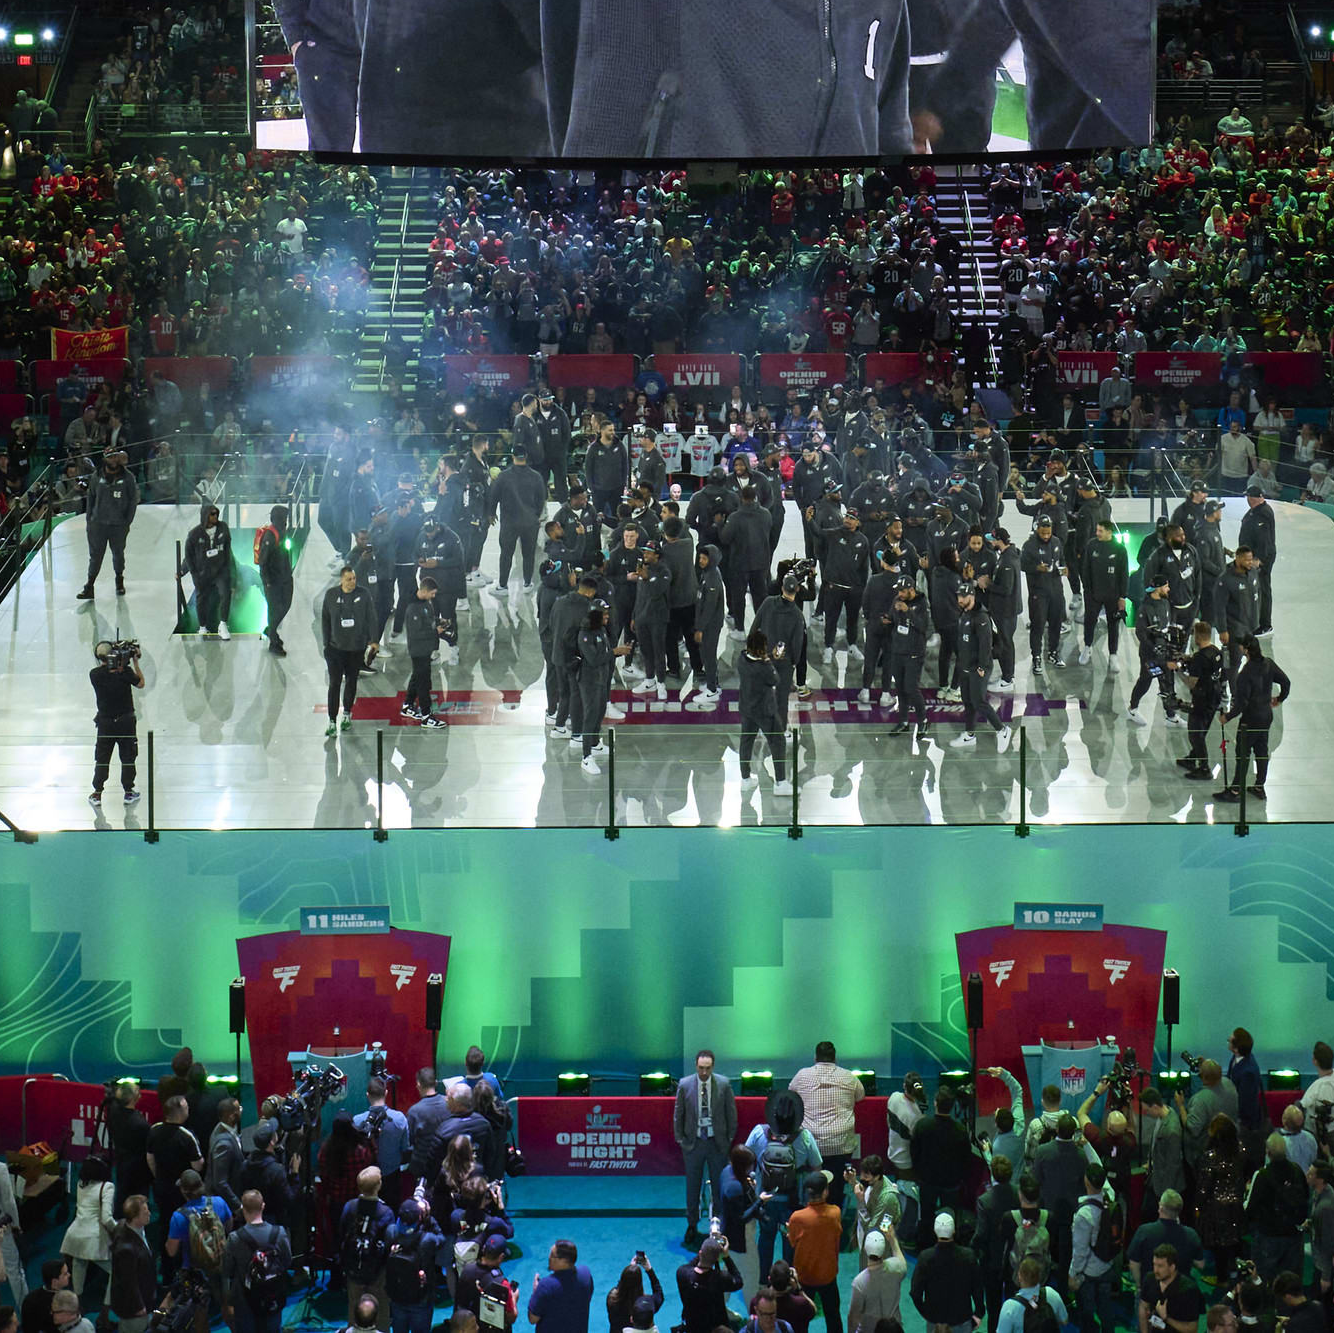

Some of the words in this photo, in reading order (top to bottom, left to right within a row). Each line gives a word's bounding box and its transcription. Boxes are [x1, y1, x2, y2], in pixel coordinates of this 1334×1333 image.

[864, 19, 881, 80] 1
[884, 271, 898, 282] 20
[1009, 269, 1022, 282] 20
[60, 310, 69, 321] 15
[161, 322, 172, 334] 10
[832, 322, 845, 335] 58
[71, 332, 113, 347] Chiefs
[673, 372, 720, 386] LVII
[307, 914, 328, 928] 11
[1023, 910, 1050, 924] 10
[1054, 911, 1097, 919] DARIUS
[332, 920, 385, 928] SANDERS
[556, 1132, 651, 1146] OPENING
[570, 1146, 636, 1159] NIGHT
[589, 1160, 609, 1169] FAST
[608, 1160, 639, 1169] TWITCH
